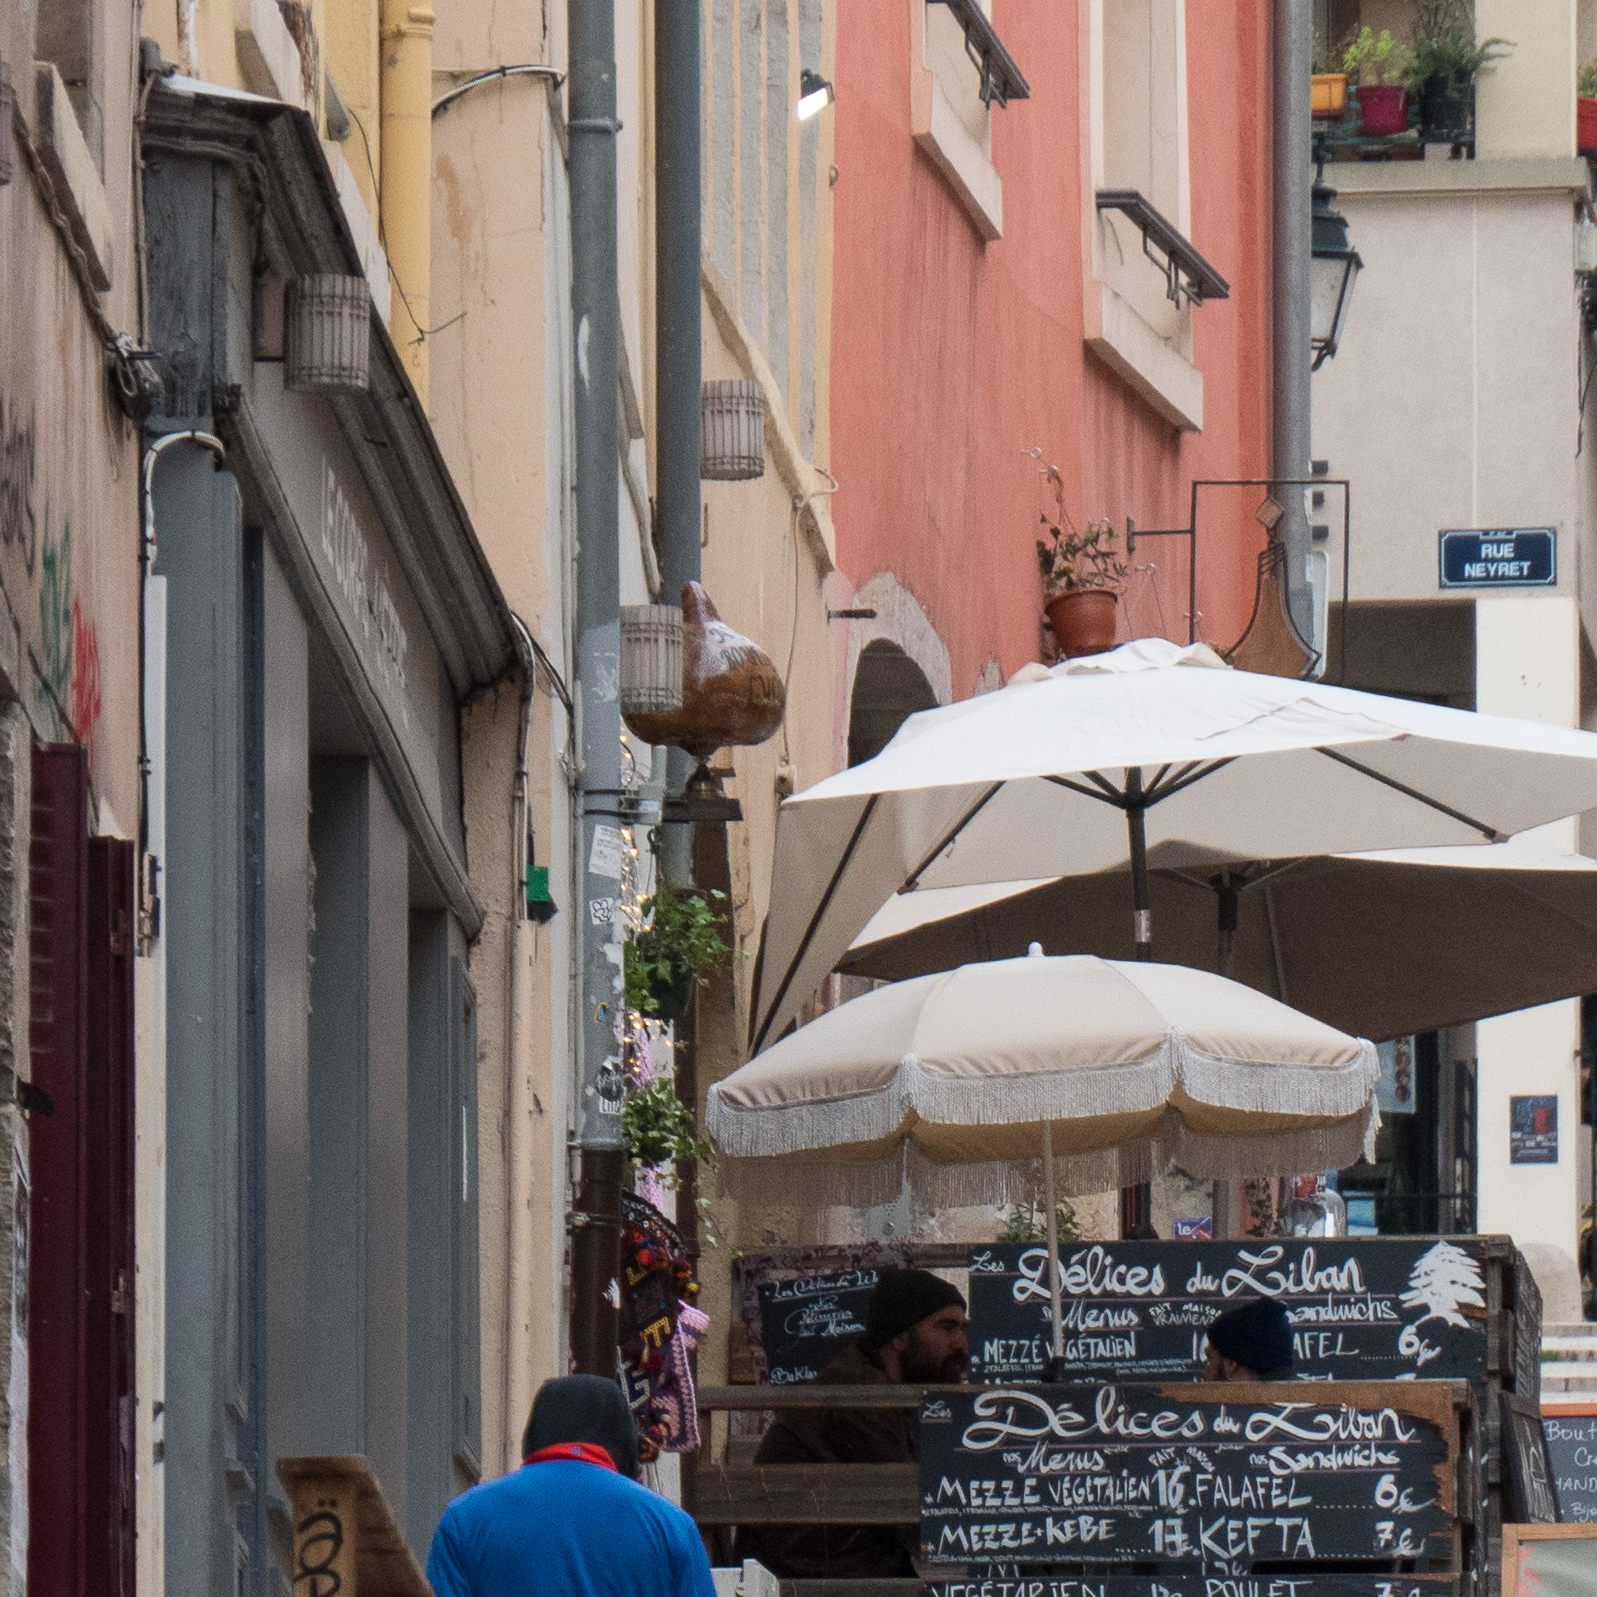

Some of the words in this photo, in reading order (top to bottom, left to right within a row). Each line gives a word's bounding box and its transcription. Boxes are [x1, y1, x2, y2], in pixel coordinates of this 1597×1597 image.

[1481, 543, 1515, 559] RUE
[1464, 561, 1531, 578] NEYRET
[1012, 1245, 1167, 1301] Délices
[1186, 1261, 1220, 1294] du
[1221, 1245, 1367, 1298] Liban
[1059, 1298, 1141, 1332] Menus
[961, 1385, 1205, 1450] Délices
[1213, 1403, 1240, 1434] du
[1244, 1401, 1416, 1443] Liban
[1017, 1439, 1105, 1474] Menus
[937, 1475, 1042, 1508] MEZZE
[1196, 1473, 1314, 1510] FALAFEL
[1198, 1516, 1317, 1560] KEFTA
